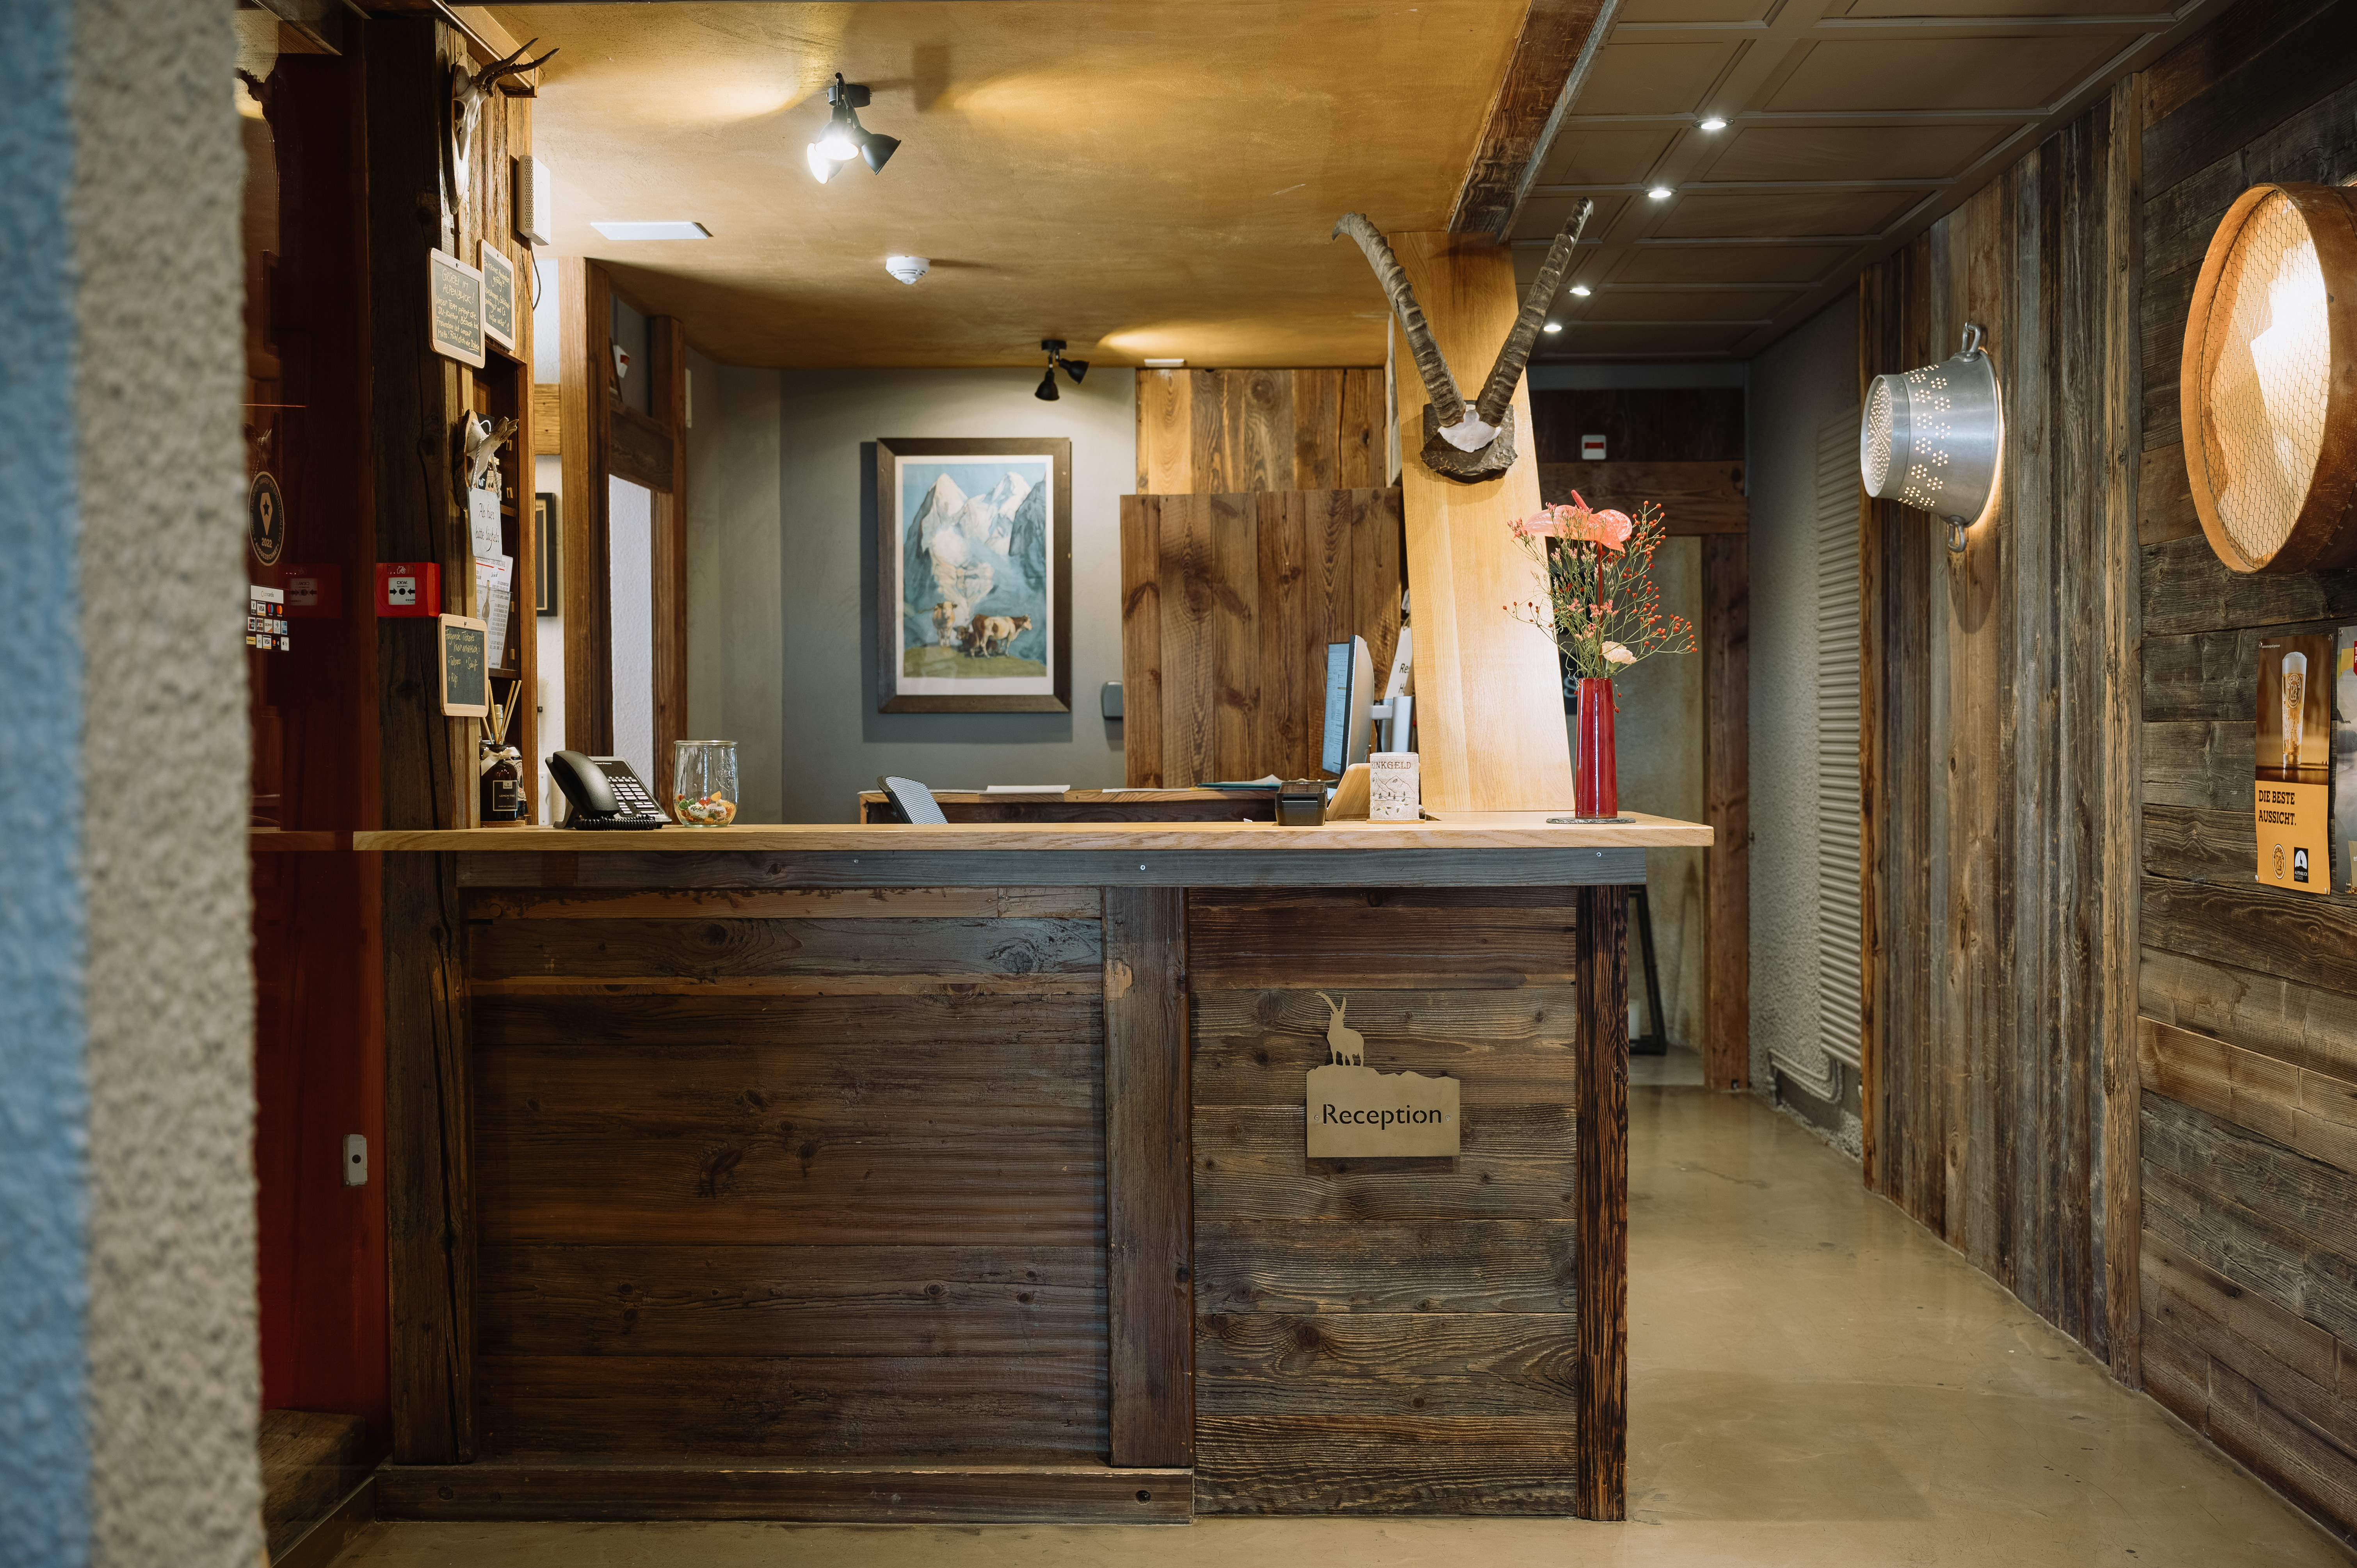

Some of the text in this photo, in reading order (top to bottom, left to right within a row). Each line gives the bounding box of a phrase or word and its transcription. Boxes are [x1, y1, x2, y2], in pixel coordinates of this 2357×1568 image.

[463, 281, 468, 291] IM
[436, 295, 447, 306] Unser
[448, 299, 457, 311] TEAM
[458, 307, 470, 319] pflegt
[436, 316, 454, 330] Freunden
[461, 328, 472, 337] unser
[461, 316, 473, 328] Besuch
[479, 503, 495, 520] Ab hier
[261, 537, 272, 548] 2022
[475, 525, 500, 553] bitte lächeln
[255, 542, 278, 560] AUSGEZEICHNET
[445, 629, 461, 645] Folgende
[462, 631, 475, 642] Tickets
[454, 642, 462, 652] hier
[2259, 790, 2295, 805] DIE BESTE
[2259, 810, 2296, 826] AUSSICHT.
[1322, 1104, 1442, 1131] Reception
